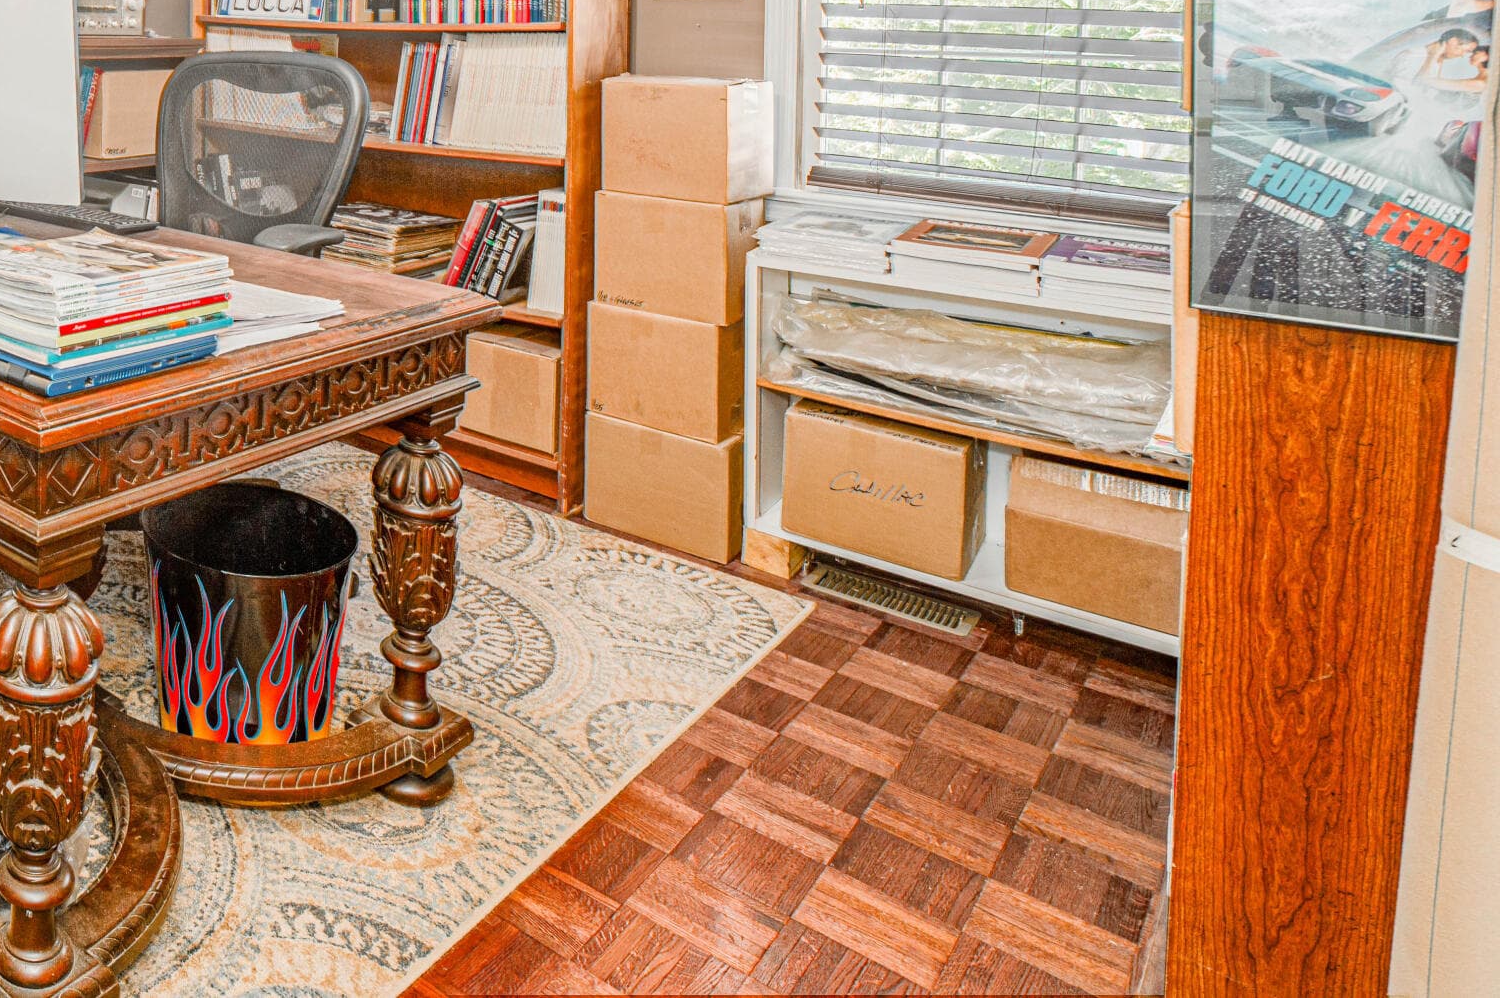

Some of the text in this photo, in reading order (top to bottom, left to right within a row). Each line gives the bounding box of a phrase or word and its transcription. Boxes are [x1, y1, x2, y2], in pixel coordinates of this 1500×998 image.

[1247, 153, 1353, 218] FORD
[1254, 196, 1326, 232] NOVEMBER
[1271, 137, 1475, 231] MATT DAMON CHRIST
